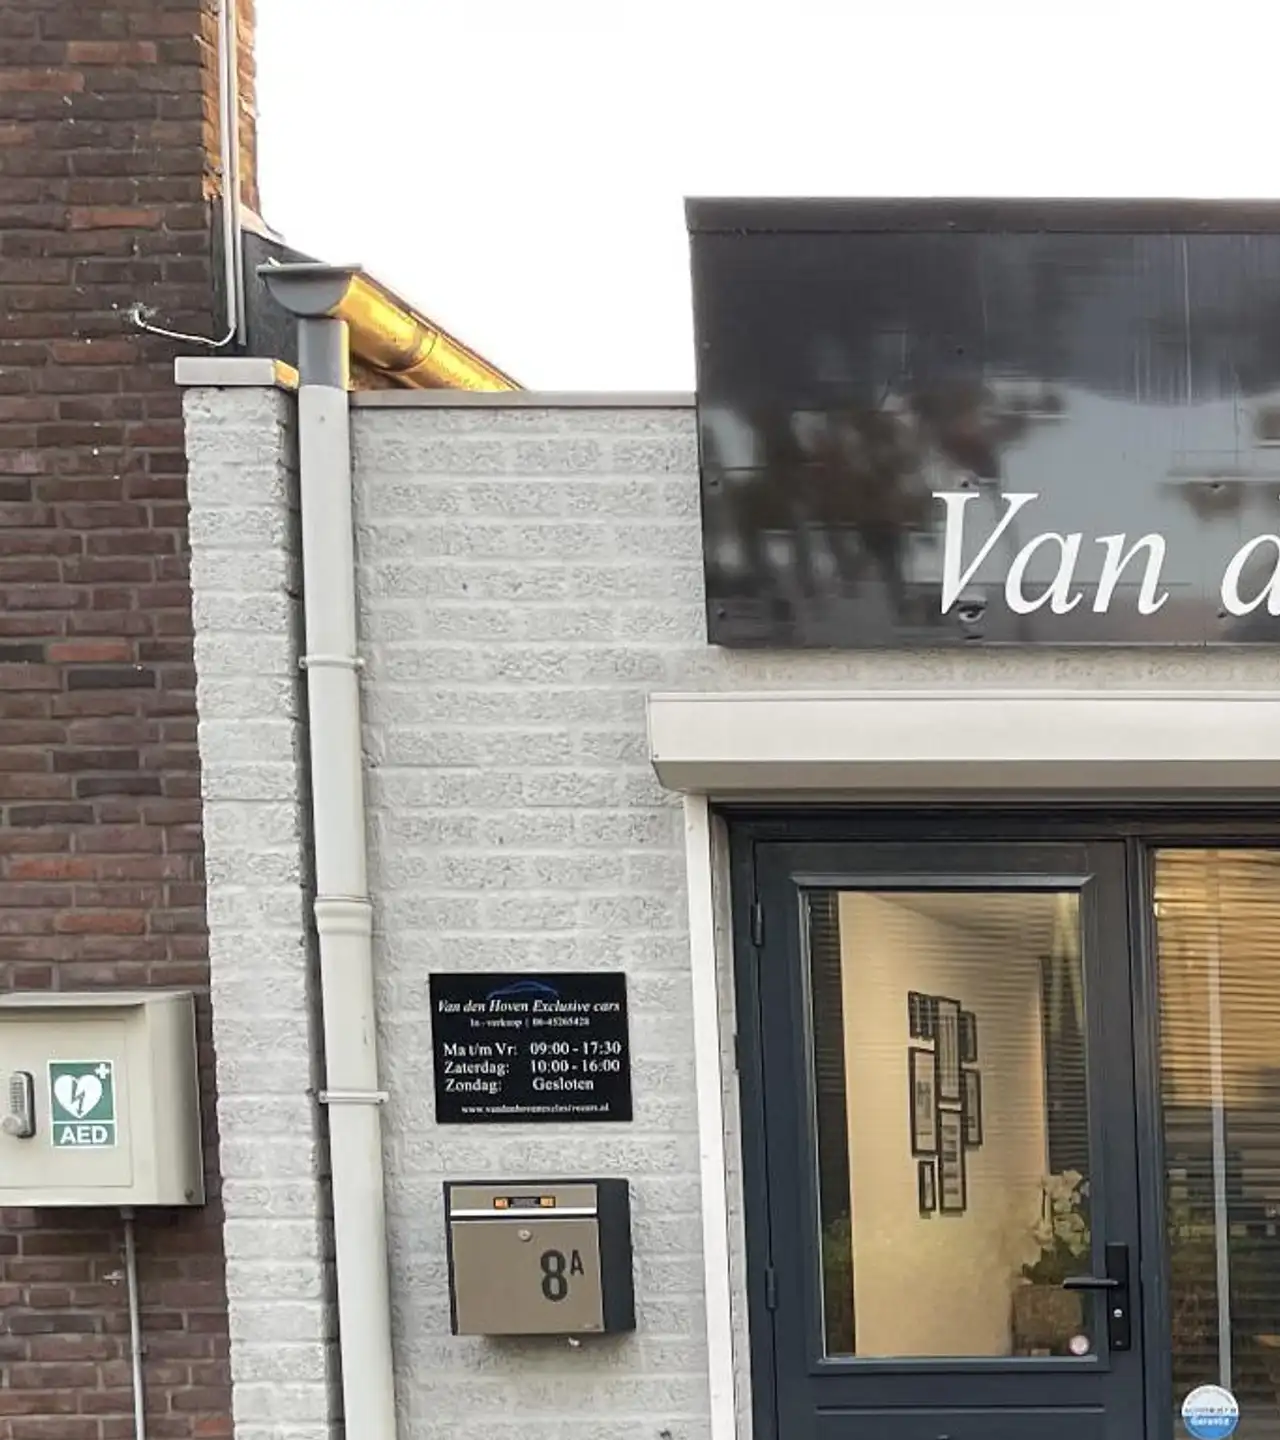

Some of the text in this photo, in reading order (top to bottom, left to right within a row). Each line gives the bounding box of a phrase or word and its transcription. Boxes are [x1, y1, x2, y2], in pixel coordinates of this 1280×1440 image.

[932, 490, 1170, 617] Van
[438, 999, 620, 1013] Van den Hoven Exclusive cars
[443, 1042, 467, 1057] Ma
[529, 1041, 570, 1056] 09:00
[583, 1040, 622, 1055] 17:30
[444, 1060, 510, 1077] Zaterdag:
[530, 1059, 570, 1073] 10:00
[582, 1059, 620, 1072] 16:00
[445, 1076, 594, 1095] Zondag: Gesloten
[60, 1125, 108, 1145] AED
